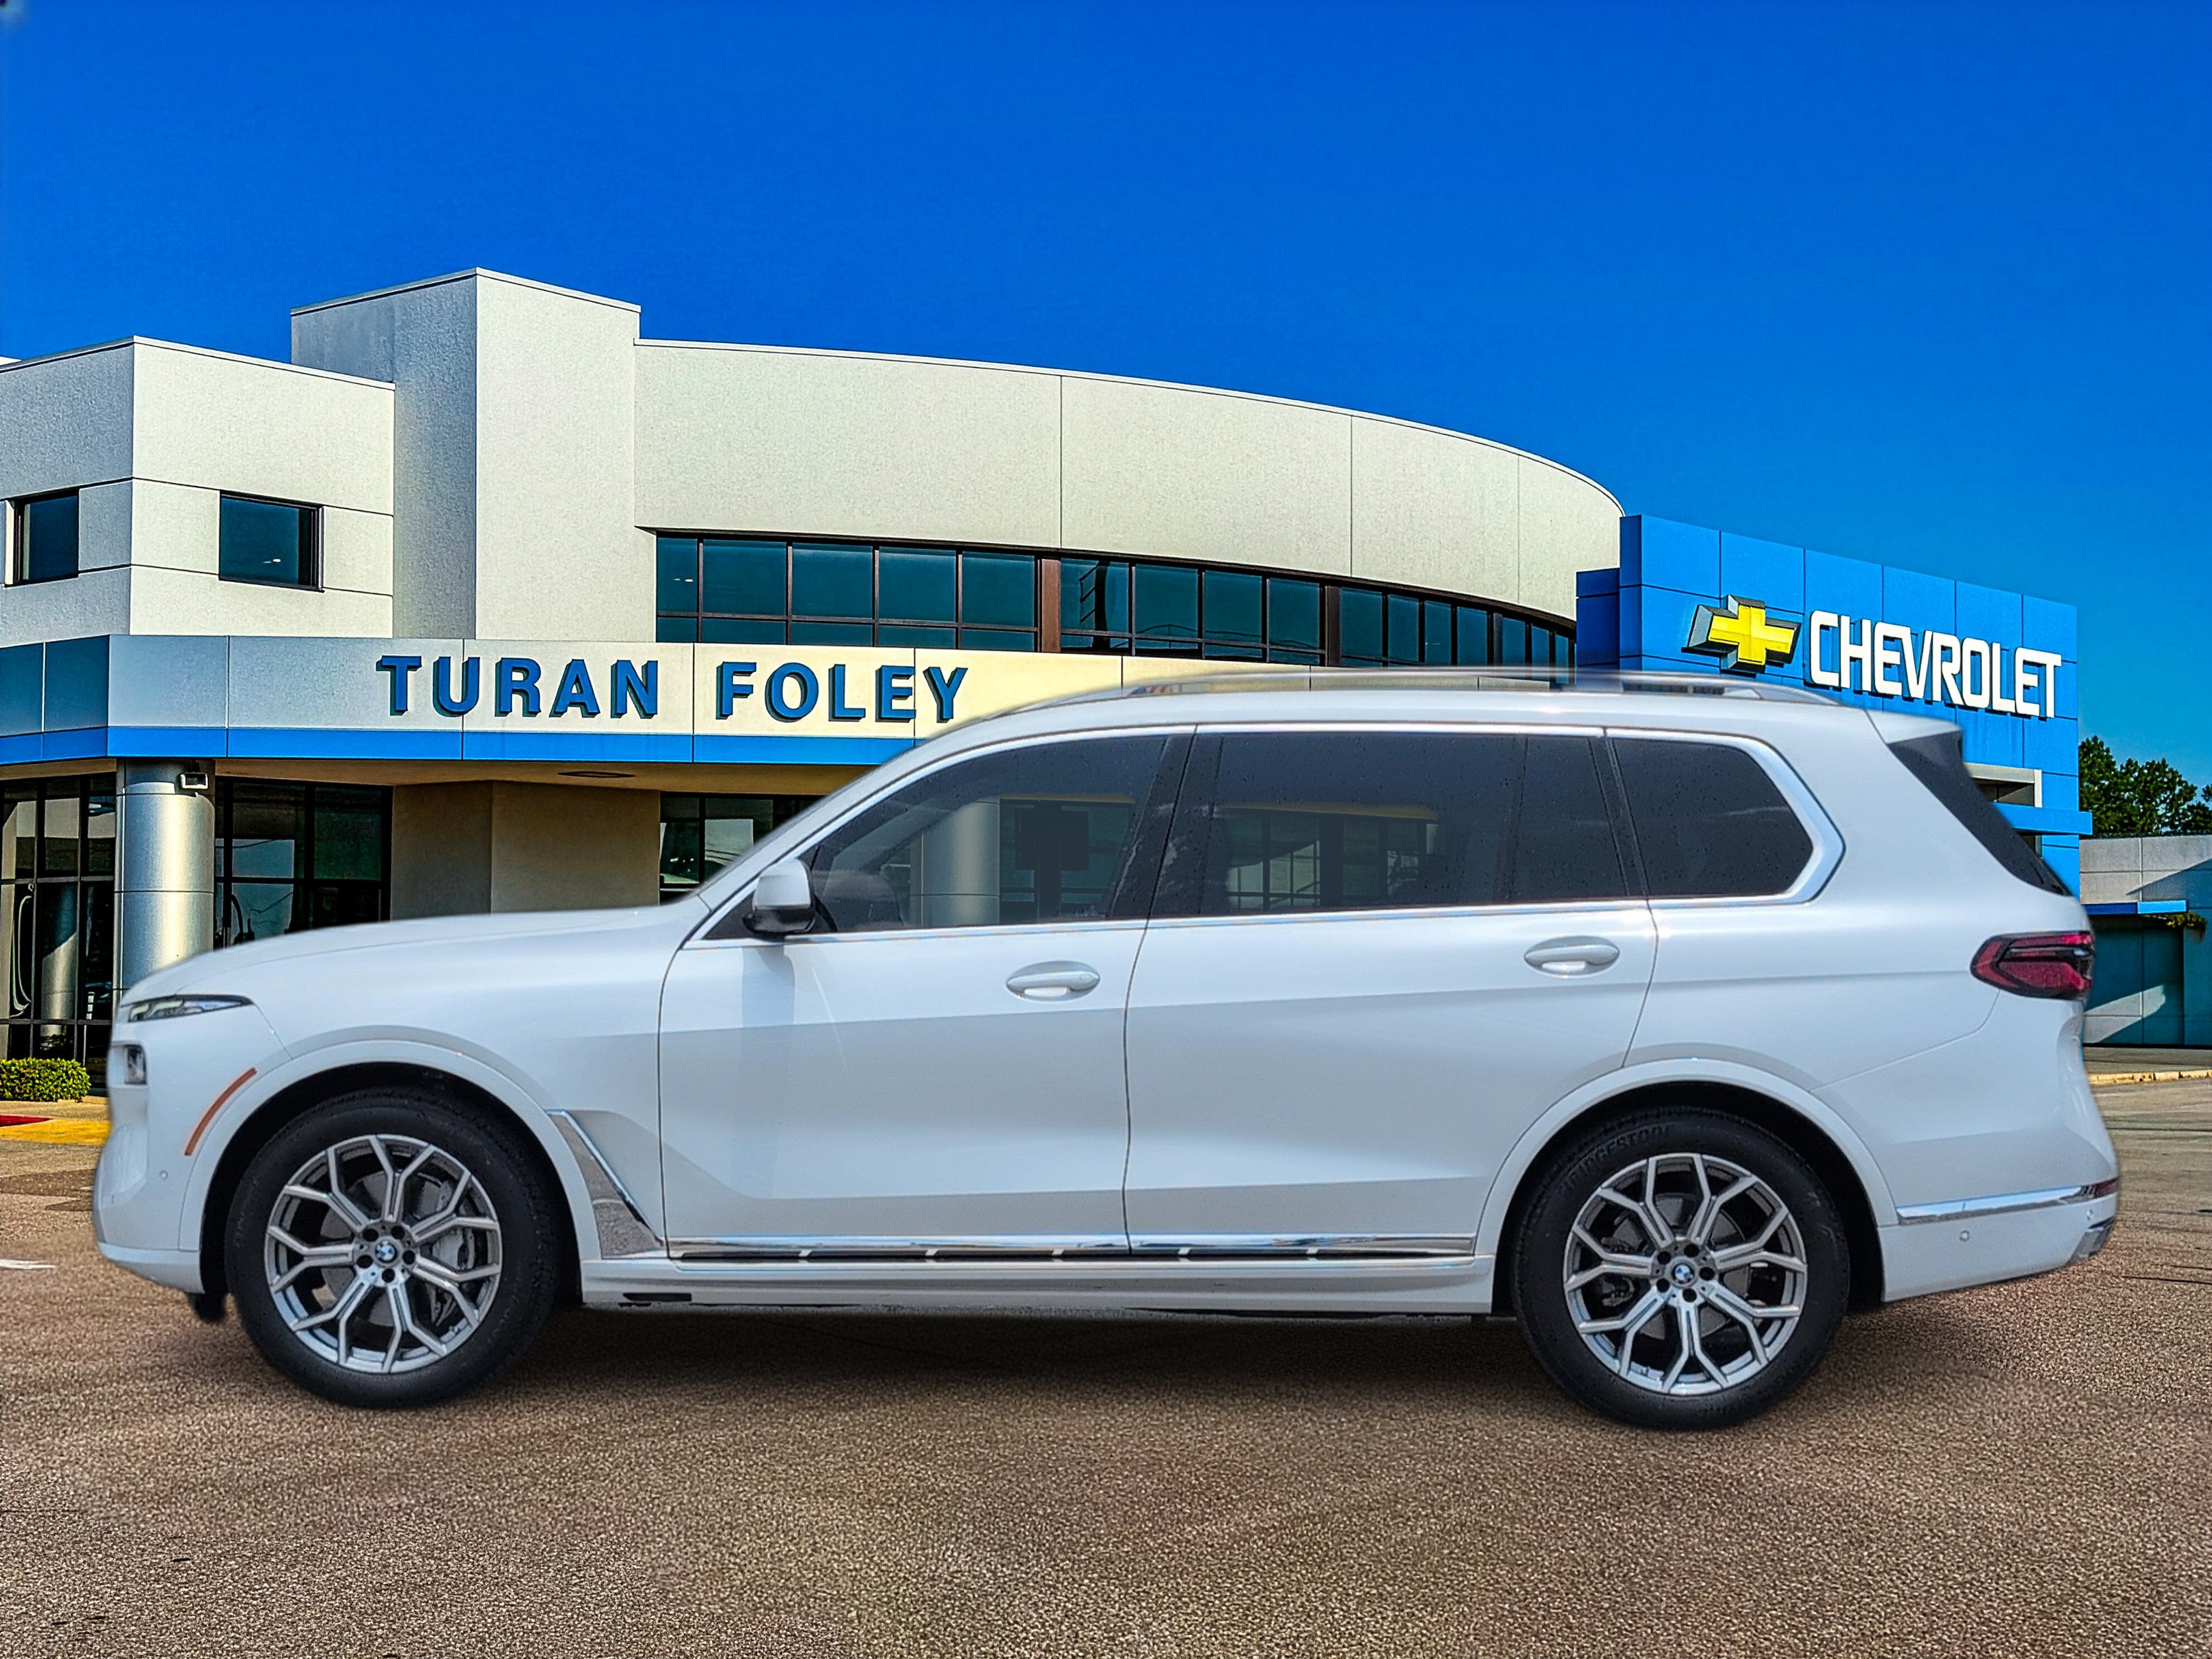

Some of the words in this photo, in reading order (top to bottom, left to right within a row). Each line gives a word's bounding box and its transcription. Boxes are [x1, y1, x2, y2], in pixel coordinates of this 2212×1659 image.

[377, 655, 658, 719] TURAN
[716, 661, 968, 723] FOLEY
[1810, 610, 2062, 718] CHEVROLET
